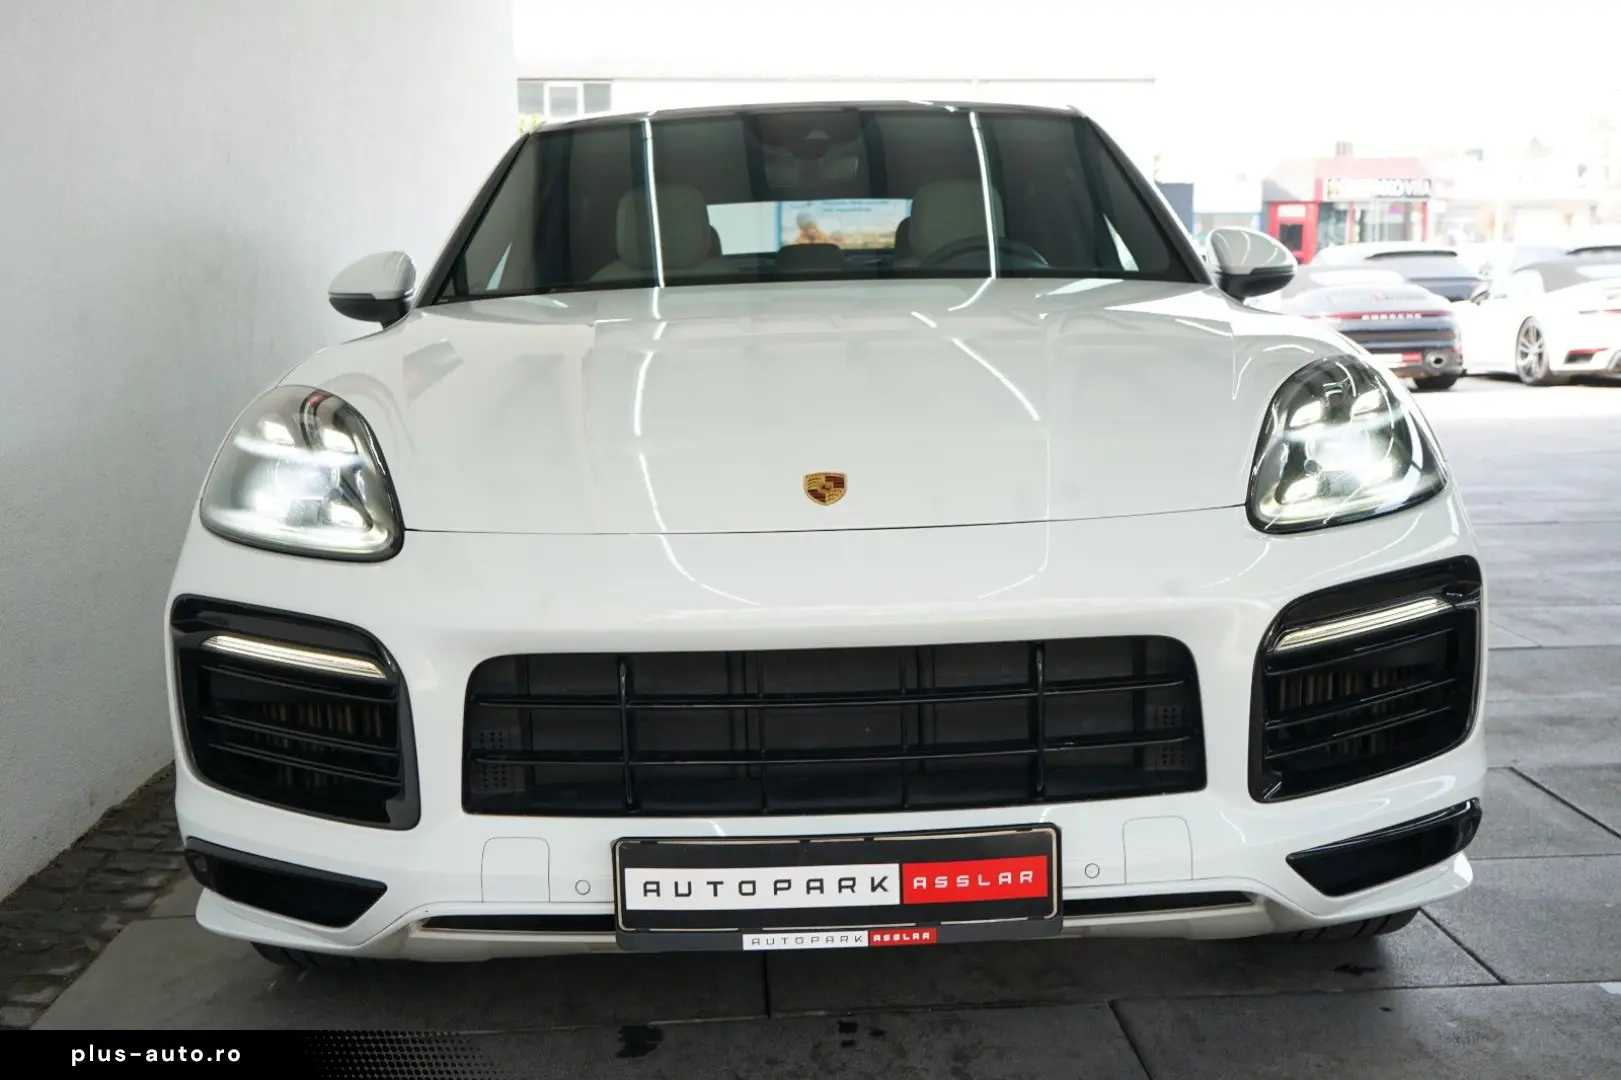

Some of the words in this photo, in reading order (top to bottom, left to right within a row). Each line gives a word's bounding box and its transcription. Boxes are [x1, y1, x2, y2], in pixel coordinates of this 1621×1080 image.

[642, 875, 890, 898] AUTOPARK
[912, 870, 1034, 890] ASSLAR
[751, 934, 864, 946] AUTOPARK
[872, 931, 931, 943] ASSLAR
